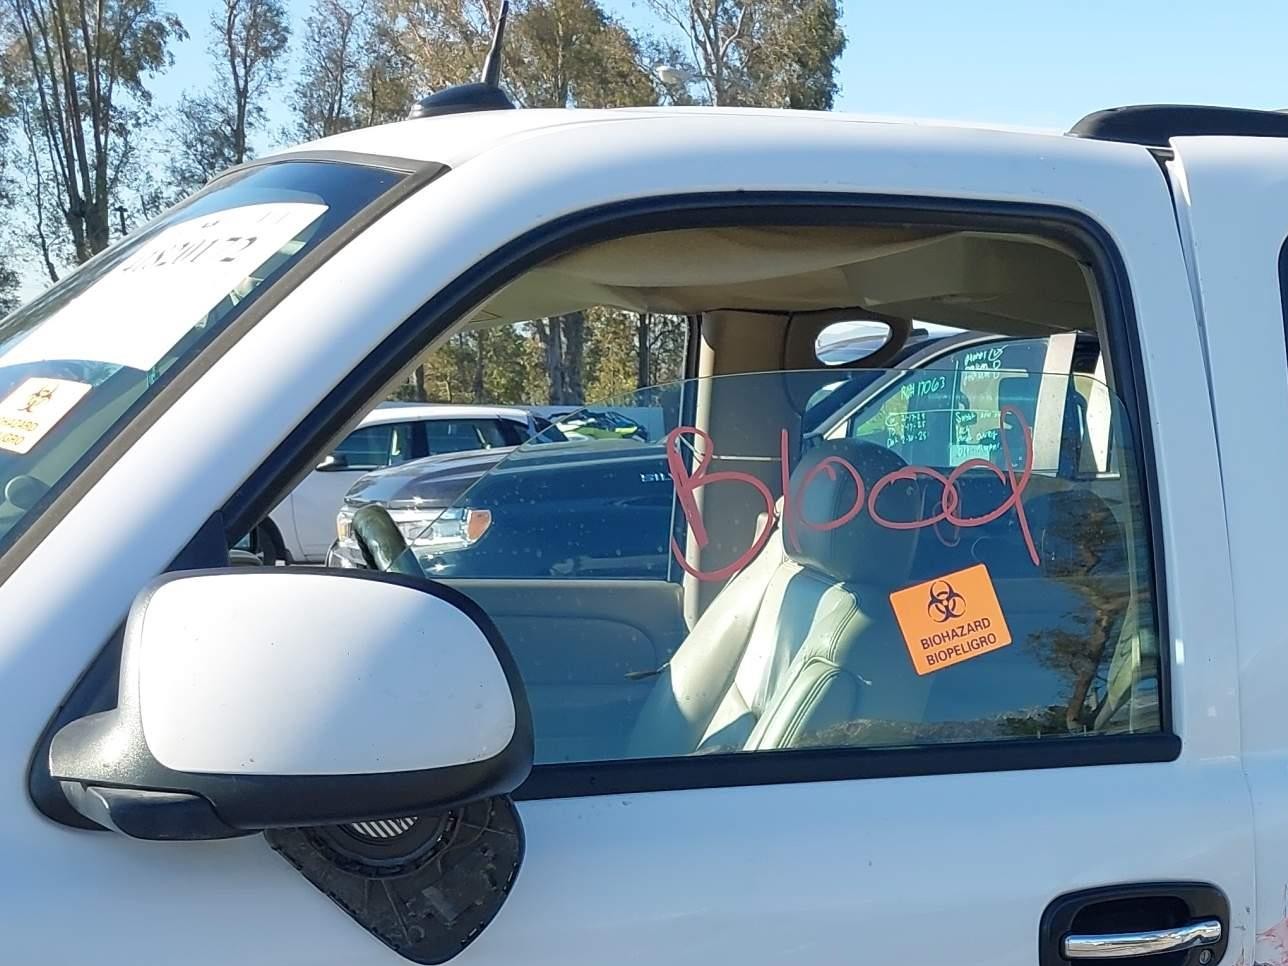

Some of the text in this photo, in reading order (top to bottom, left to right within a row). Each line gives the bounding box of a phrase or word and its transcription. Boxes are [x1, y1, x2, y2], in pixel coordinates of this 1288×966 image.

[668, 406, 1040, 581] Blood
[920, 617, 991, 650] BIOHAZARD
[926, 633, 997, 666] BIOPELIGRO
